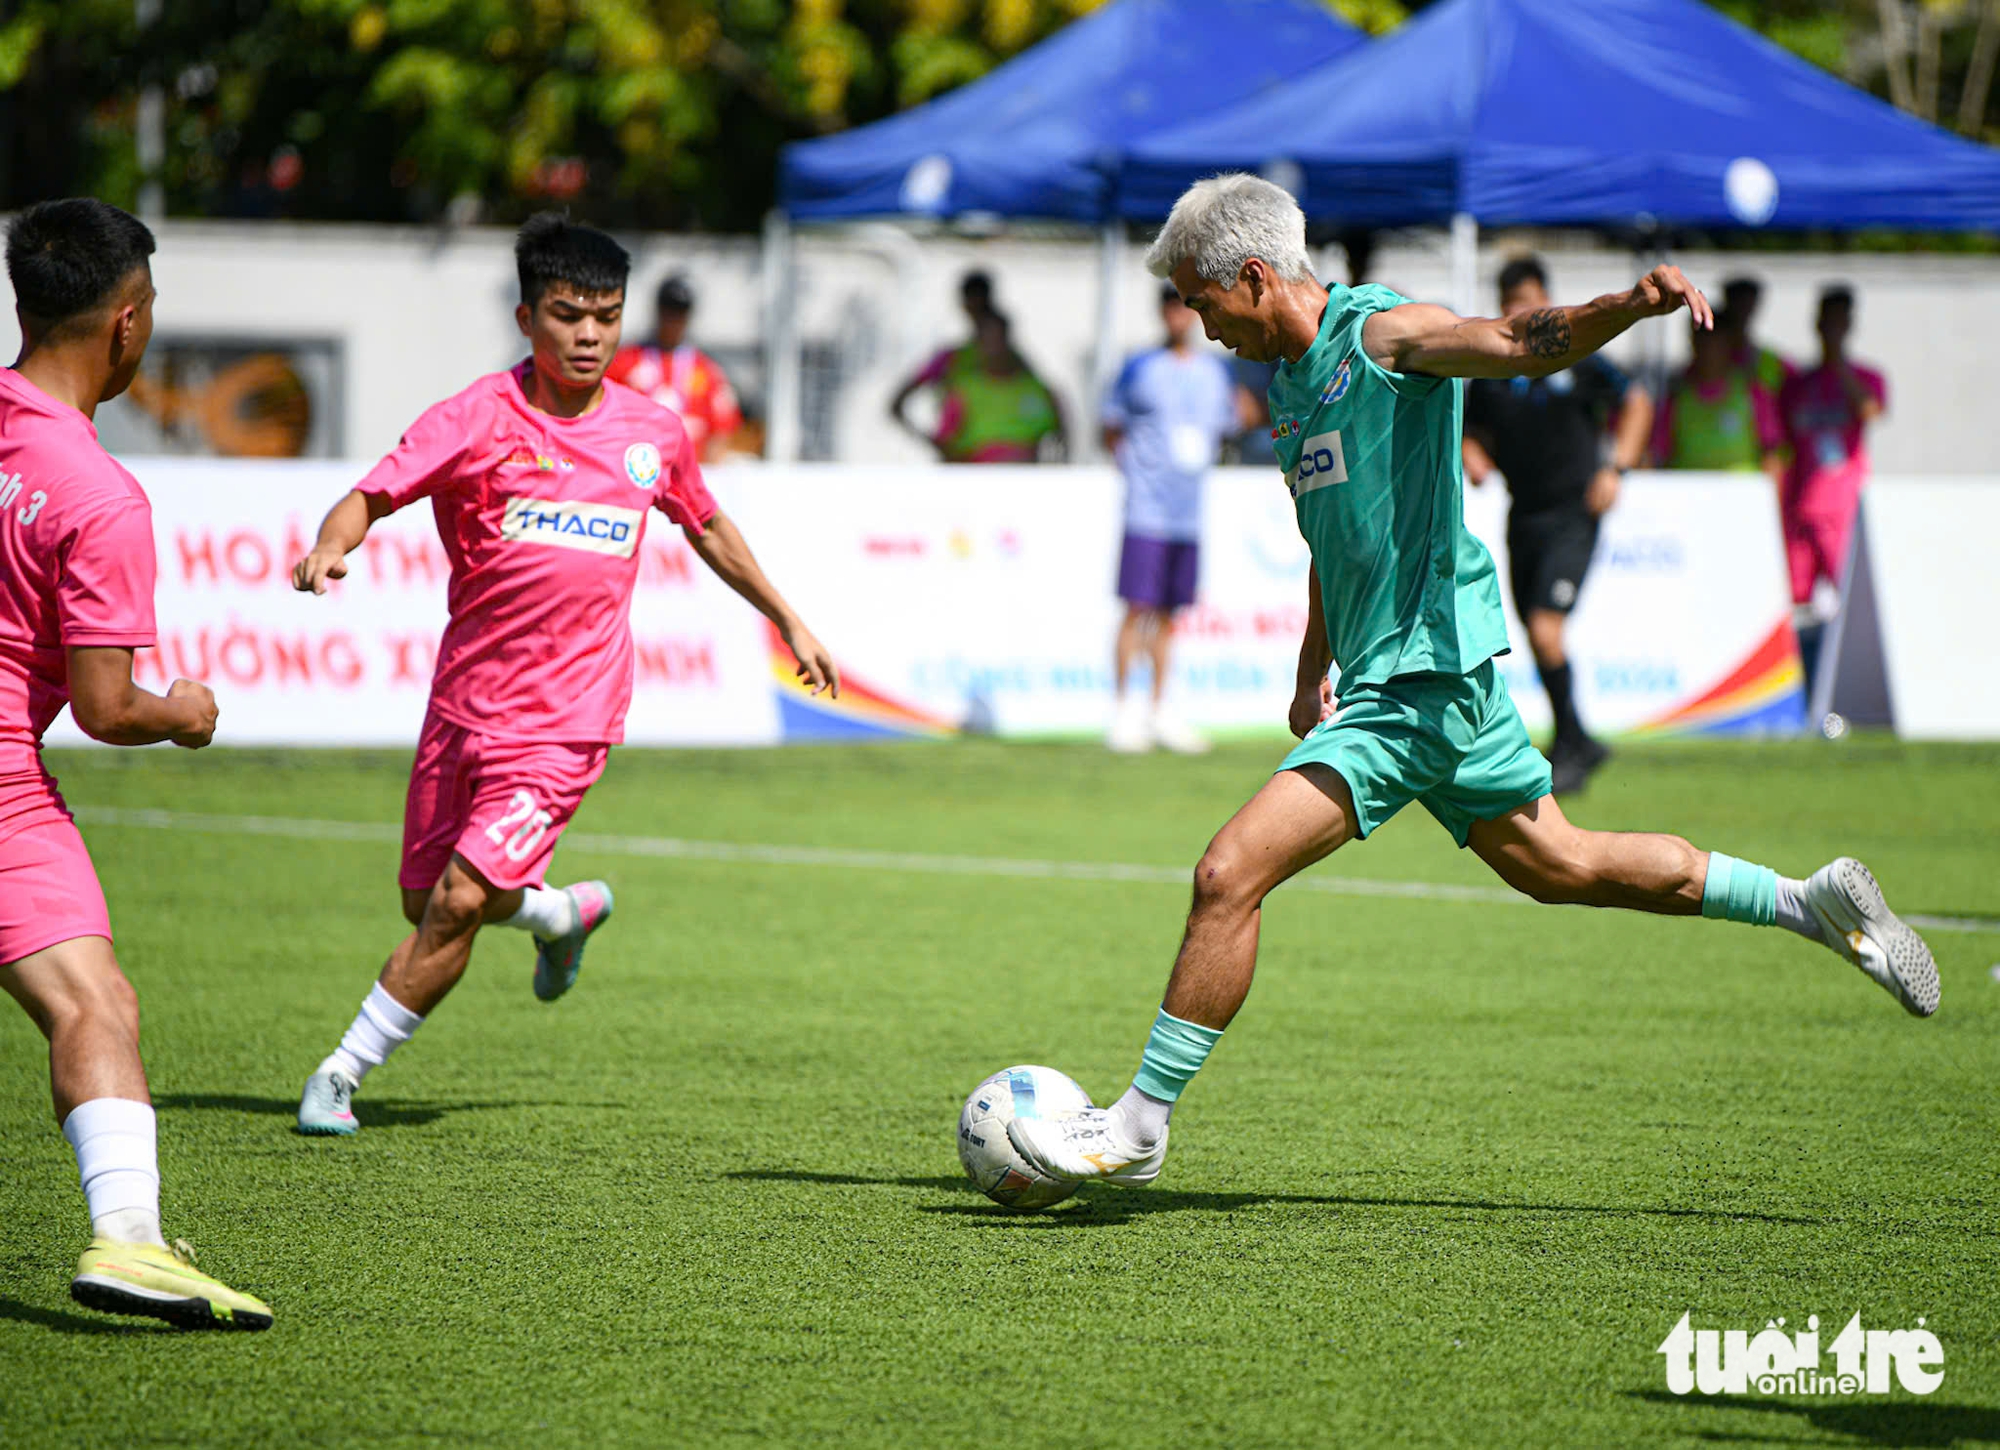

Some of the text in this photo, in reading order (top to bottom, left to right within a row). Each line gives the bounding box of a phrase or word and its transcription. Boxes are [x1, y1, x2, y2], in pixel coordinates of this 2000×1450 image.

[17, 490, 47, 526] 3
[517, 510, 630, 542] THACO
[485, 790, 553, 861] 20
